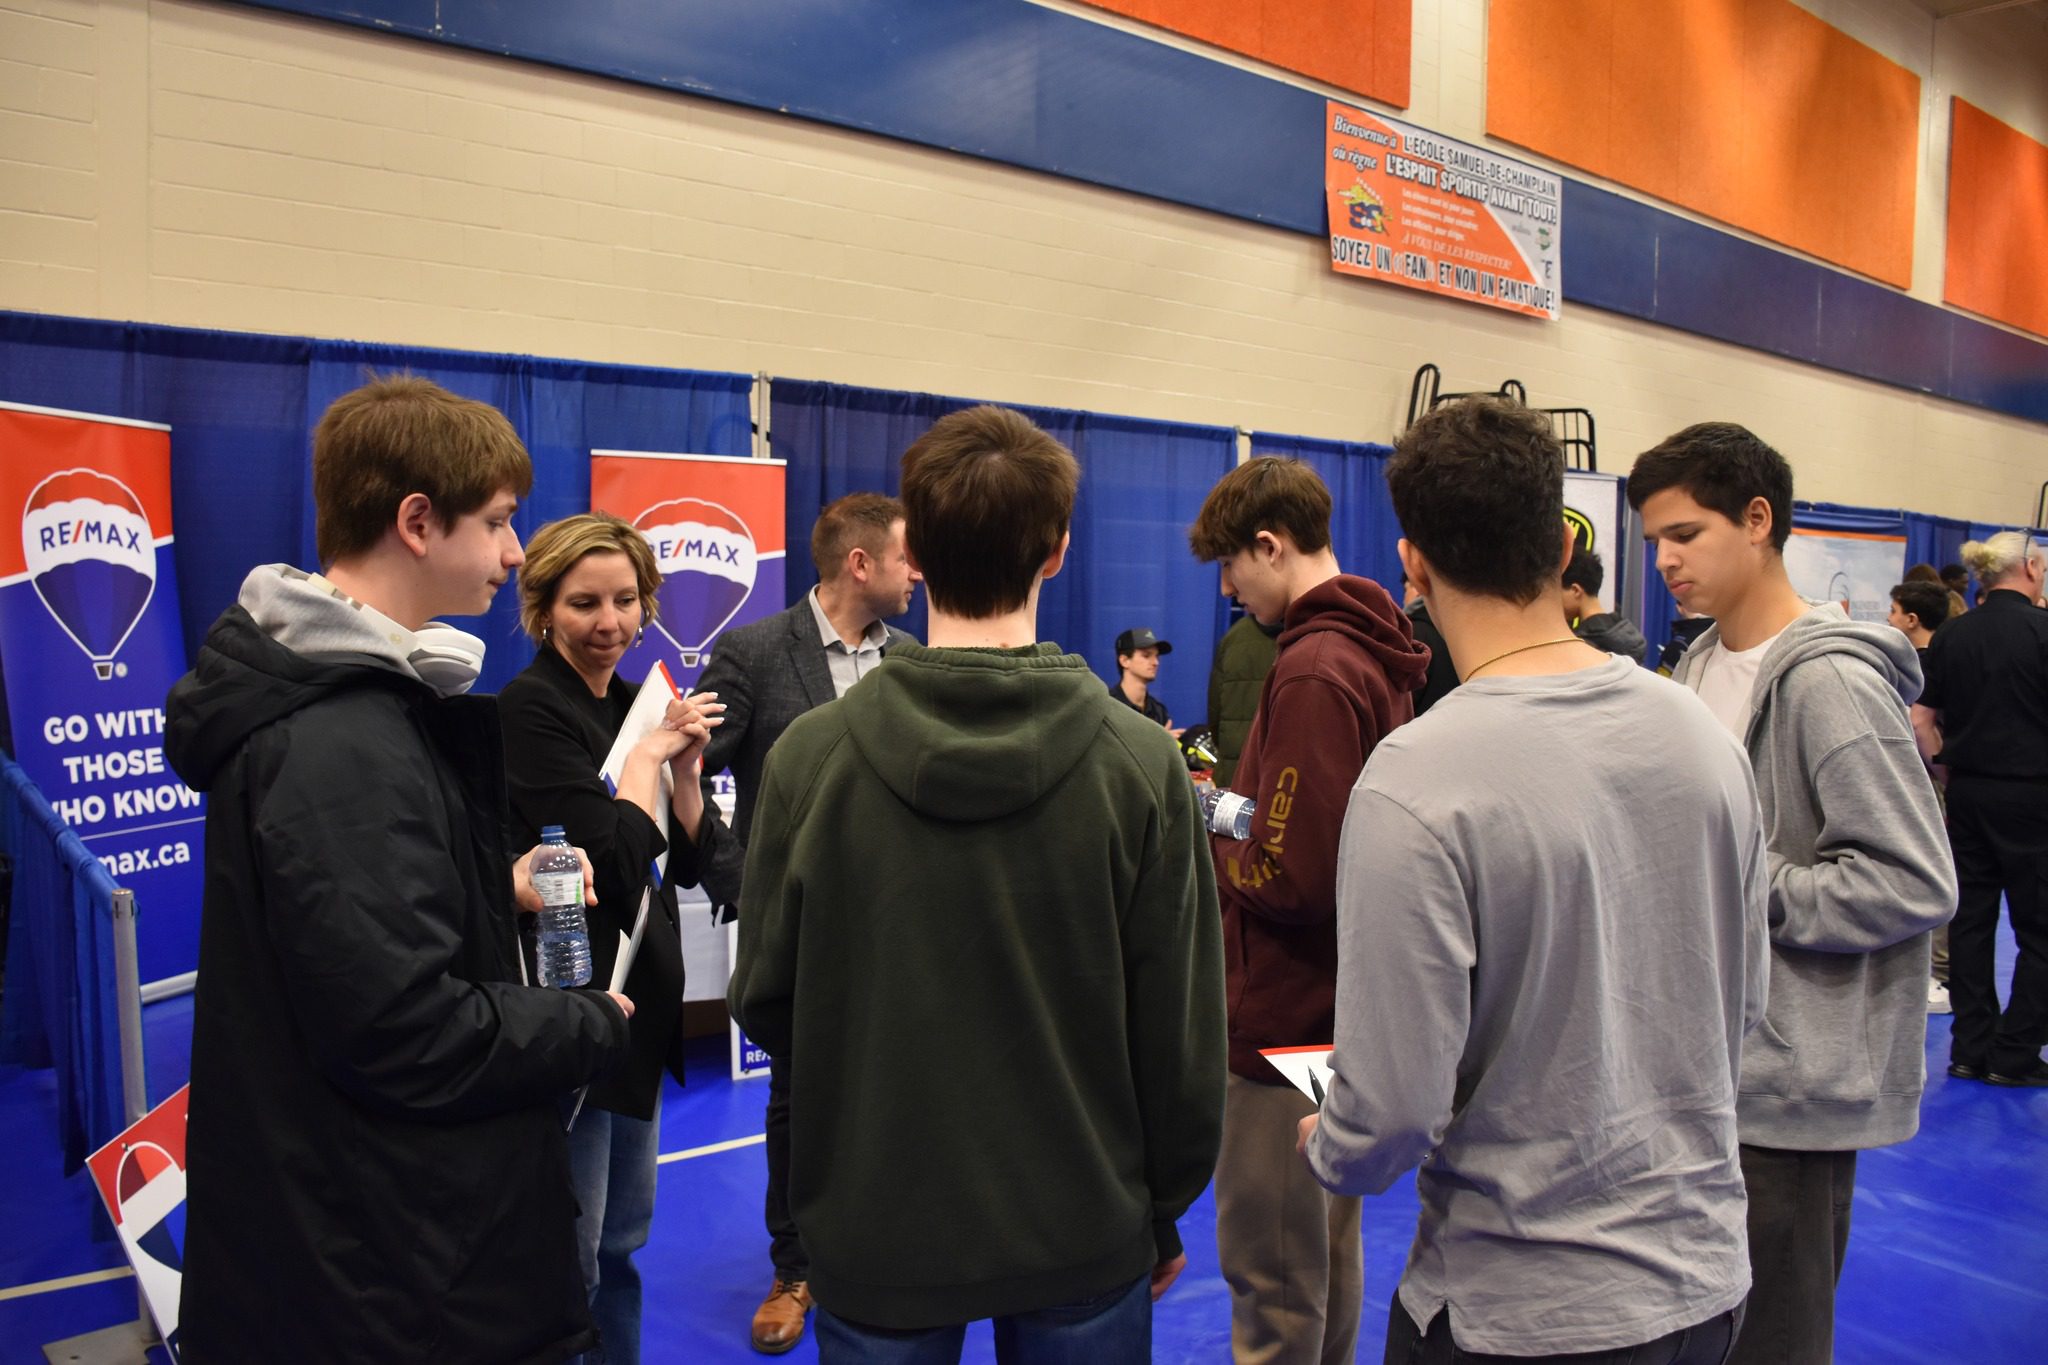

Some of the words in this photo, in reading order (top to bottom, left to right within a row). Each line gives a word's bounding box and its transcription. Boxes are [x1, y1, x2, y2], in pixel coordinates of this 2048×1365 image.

[1333, 113, 1389, 147] Bienvenue
[1447, 148, 1556, 198] SAMUEL-DE-CHAMPLAIN
[1385, 153, 1438, 188] L'ESPRIT
[1439, 169, 1488, 203] SPORTIF
[1490, 185, 1525, 215] AVANT
[1526, 197, 1557, 225] TOUT!
[1332, 236, 1371, 267] SOYEZ
[1376, 245, 1391, 272] UN
[1439, 262, 1451, 286] ET
[1455, 265, 1477, 292] NON
[1480, 272, 1495, 296] UN
[1498, 277, 1555, 311] FANATIQUE!
[40, 519, 141, 554] RE/MAX
[44, 716, 89, 745] GO
[63, 747, 165, 784] THOSE
[113, 784, 201, 818] KNOW
